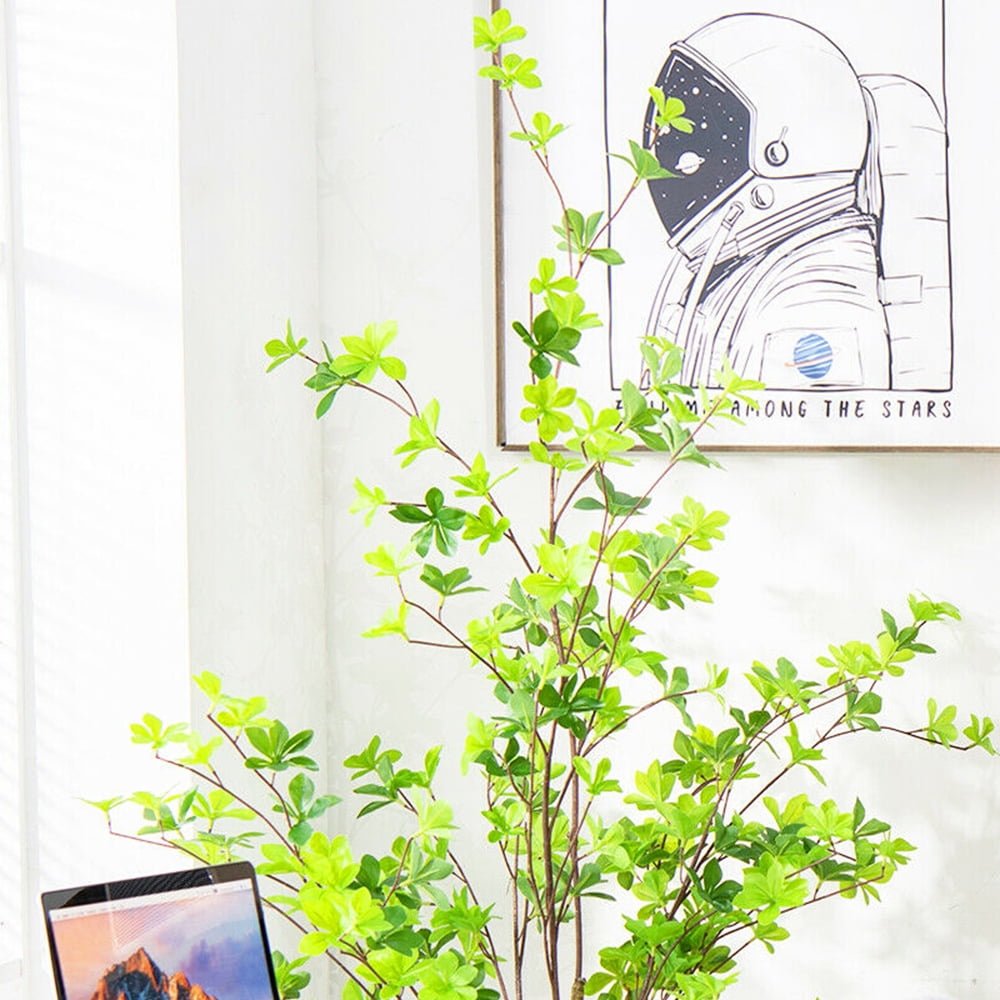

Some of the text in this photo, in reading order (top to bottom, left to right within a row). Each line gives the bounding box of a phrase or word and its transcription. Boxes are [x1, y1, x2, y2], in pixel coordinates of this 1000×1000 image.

[731, 399, 807, 418] AMONG
[823, 399, 865, 418] THE
[882, 399, 952, 418] STARS
